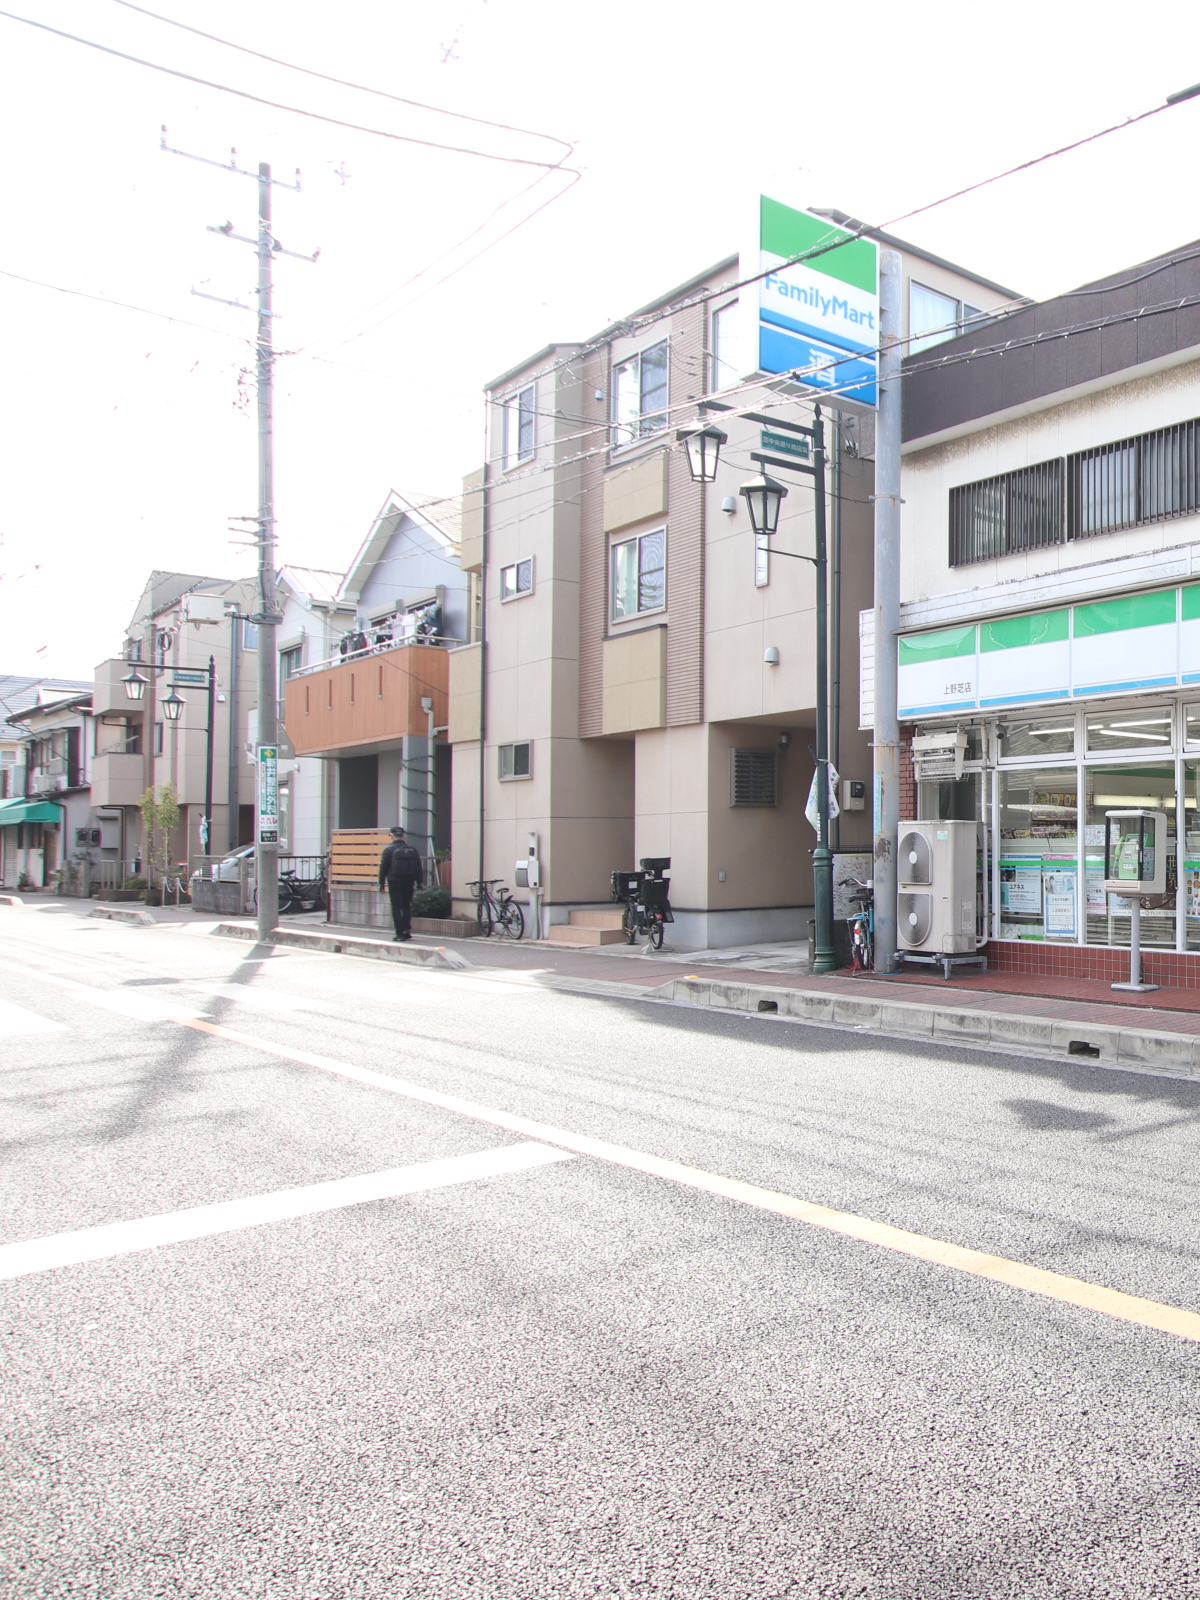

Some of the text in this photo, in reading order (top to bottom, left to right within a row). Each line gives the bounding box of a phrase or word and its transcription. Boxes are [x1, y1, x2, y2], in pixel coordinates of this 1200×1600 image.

[765, 271, 875, 331] FamilyMart
[809, 347, 836, 386] 酒
[943, 682, 972, 696] 上野芝店
